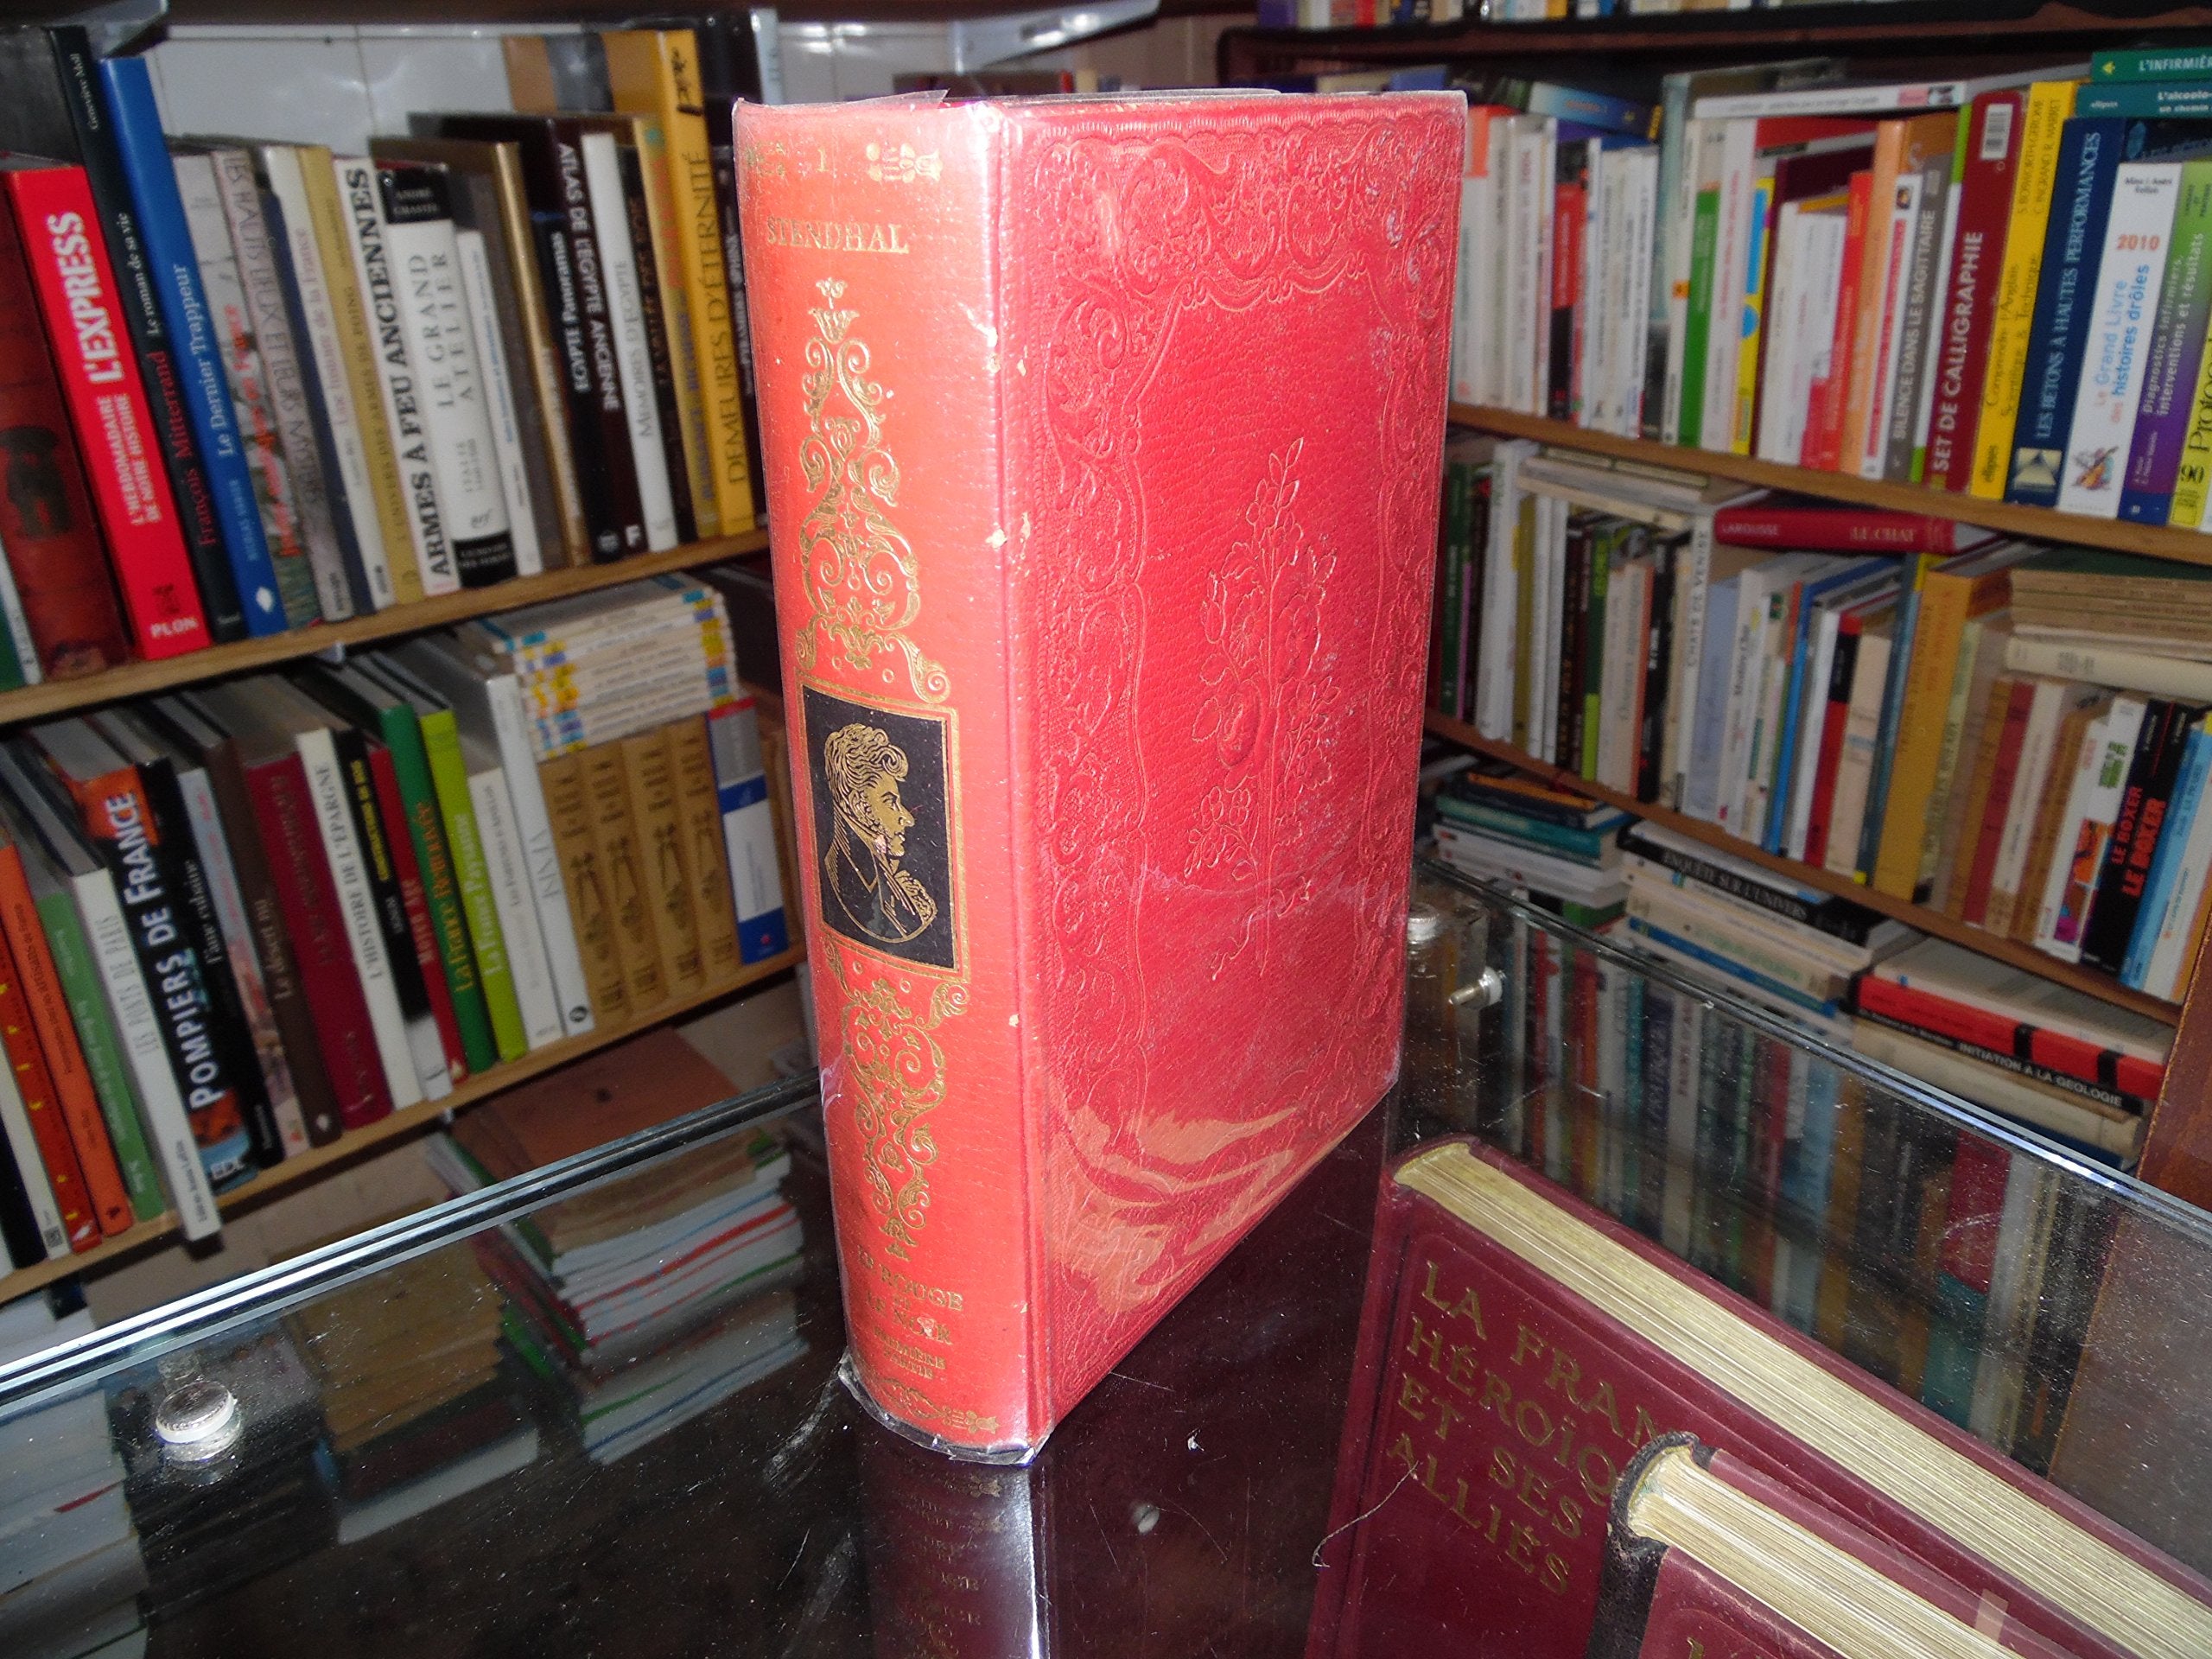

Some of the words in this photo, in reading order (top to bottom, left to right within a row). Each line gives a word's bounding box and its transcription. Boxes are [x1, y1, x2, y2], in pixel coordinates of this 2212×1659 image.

[555, 140, 584, 205] ATLAS
[2062, 130, 2104, 264] PERFORMANCES
[114, 211, 131, 234] vie
[123, 234, 137, 251] sa
[567, 206, 589, 232] DE
[679, 148, 732, 321] D'ÉTERNITÉ
[766, 215, 910, 253] STENDHAL
[2117, 234, 2160, 252] 2010
[125, 251, 142, 270] de
[344, 165, 406, 368] ANCIENNES
[1907, 208, 1940, 304] SAGITTAIRE
[2178, 231, 2204, 297] résultats
[46, 207, 124, 388] L'EXPRESS
[133, 271, 154, 316] roman
[168, 261, 211, 355] Trappeur
[406, 253, 445, 363] GRAND
[1906, 306, 1923, 325] LE
[1938, 230, 1987, 397] CALLIGRAPHIE
[2051, 266, 2080, 333] HAUTES
[2103, 277, 2131, 327] Livre
[2176, 301, 2190, 318] et
[143, 316, 160, 336] Le
[429, 251, 474, 402] ATELIER
[1899, 327, 1922, 373] DANS
[2110, 324, 2138, 397] histoires
[2124, 262, 2151, 321] drôles
[587, 317, 622, 412] ANCIENNE
[2091, 330, 2121, 386] Grand
[2140, 334, 2171, 414] Diagnostics
[2155, 321, 2187, 416] interventions
[144, 348, 194, 461] Mitterrand
[194, 356, 227, 429] Dernier
[388, 369, 421, 437] FEU
[430, 376, 454, 410] LE
[707, 330, 751, 482] DEMEURES
[1890, 375, 1916, 440] SILENCE
[1936, 401, 1959, 431] DE
[112, 390, 143, 456] HISTOIRE
[213, 433, 235, 457] Le
[2035, 410, 2055, 438] LES
[130, 456, 156, 501] NOTRE
[1929, 436, 1954, 471] SET
[143, 503, 161, 522] DE
[178, 466, 220, 548] François
[410, 471, 450, 578] ARMES
[150, 616, 198, 638] PLON
[2113, 784, 2144, 844] BOXER
[2128, 794, 2168, 869] BOXER
[102, 789, 164, 904] FRANCE
[339, 861, 359, 885] DE
[448, 811, 487, 893] Paysanne
[2109, 842, 2128, 865] LE
[2120, 870, 2146, 898] LE
[93, 912, 129, 957] PARIS
[138, 906, 176, 947] DE
[346, 887, 385, 980] L'HISTOIRE
[466, 893, 499, 951] France
[108, 958, 137, 981] DE
[480, 950, 504, 976] La
[115, 982, 150, 1027] PONTS
[149, 951, 226, 1109] POMPIERS
[2033, 1066, 2054, 1084] LA
[878, 1263, 963, 1312] ROUGE
[1421, 1260, 1488, 1341] LA
[1397, 1372, 1465, 1441] ET
[1488, 1446, 1586, 1540] SES
[1385, 1431, 1571, 1596] ALLIÉS
